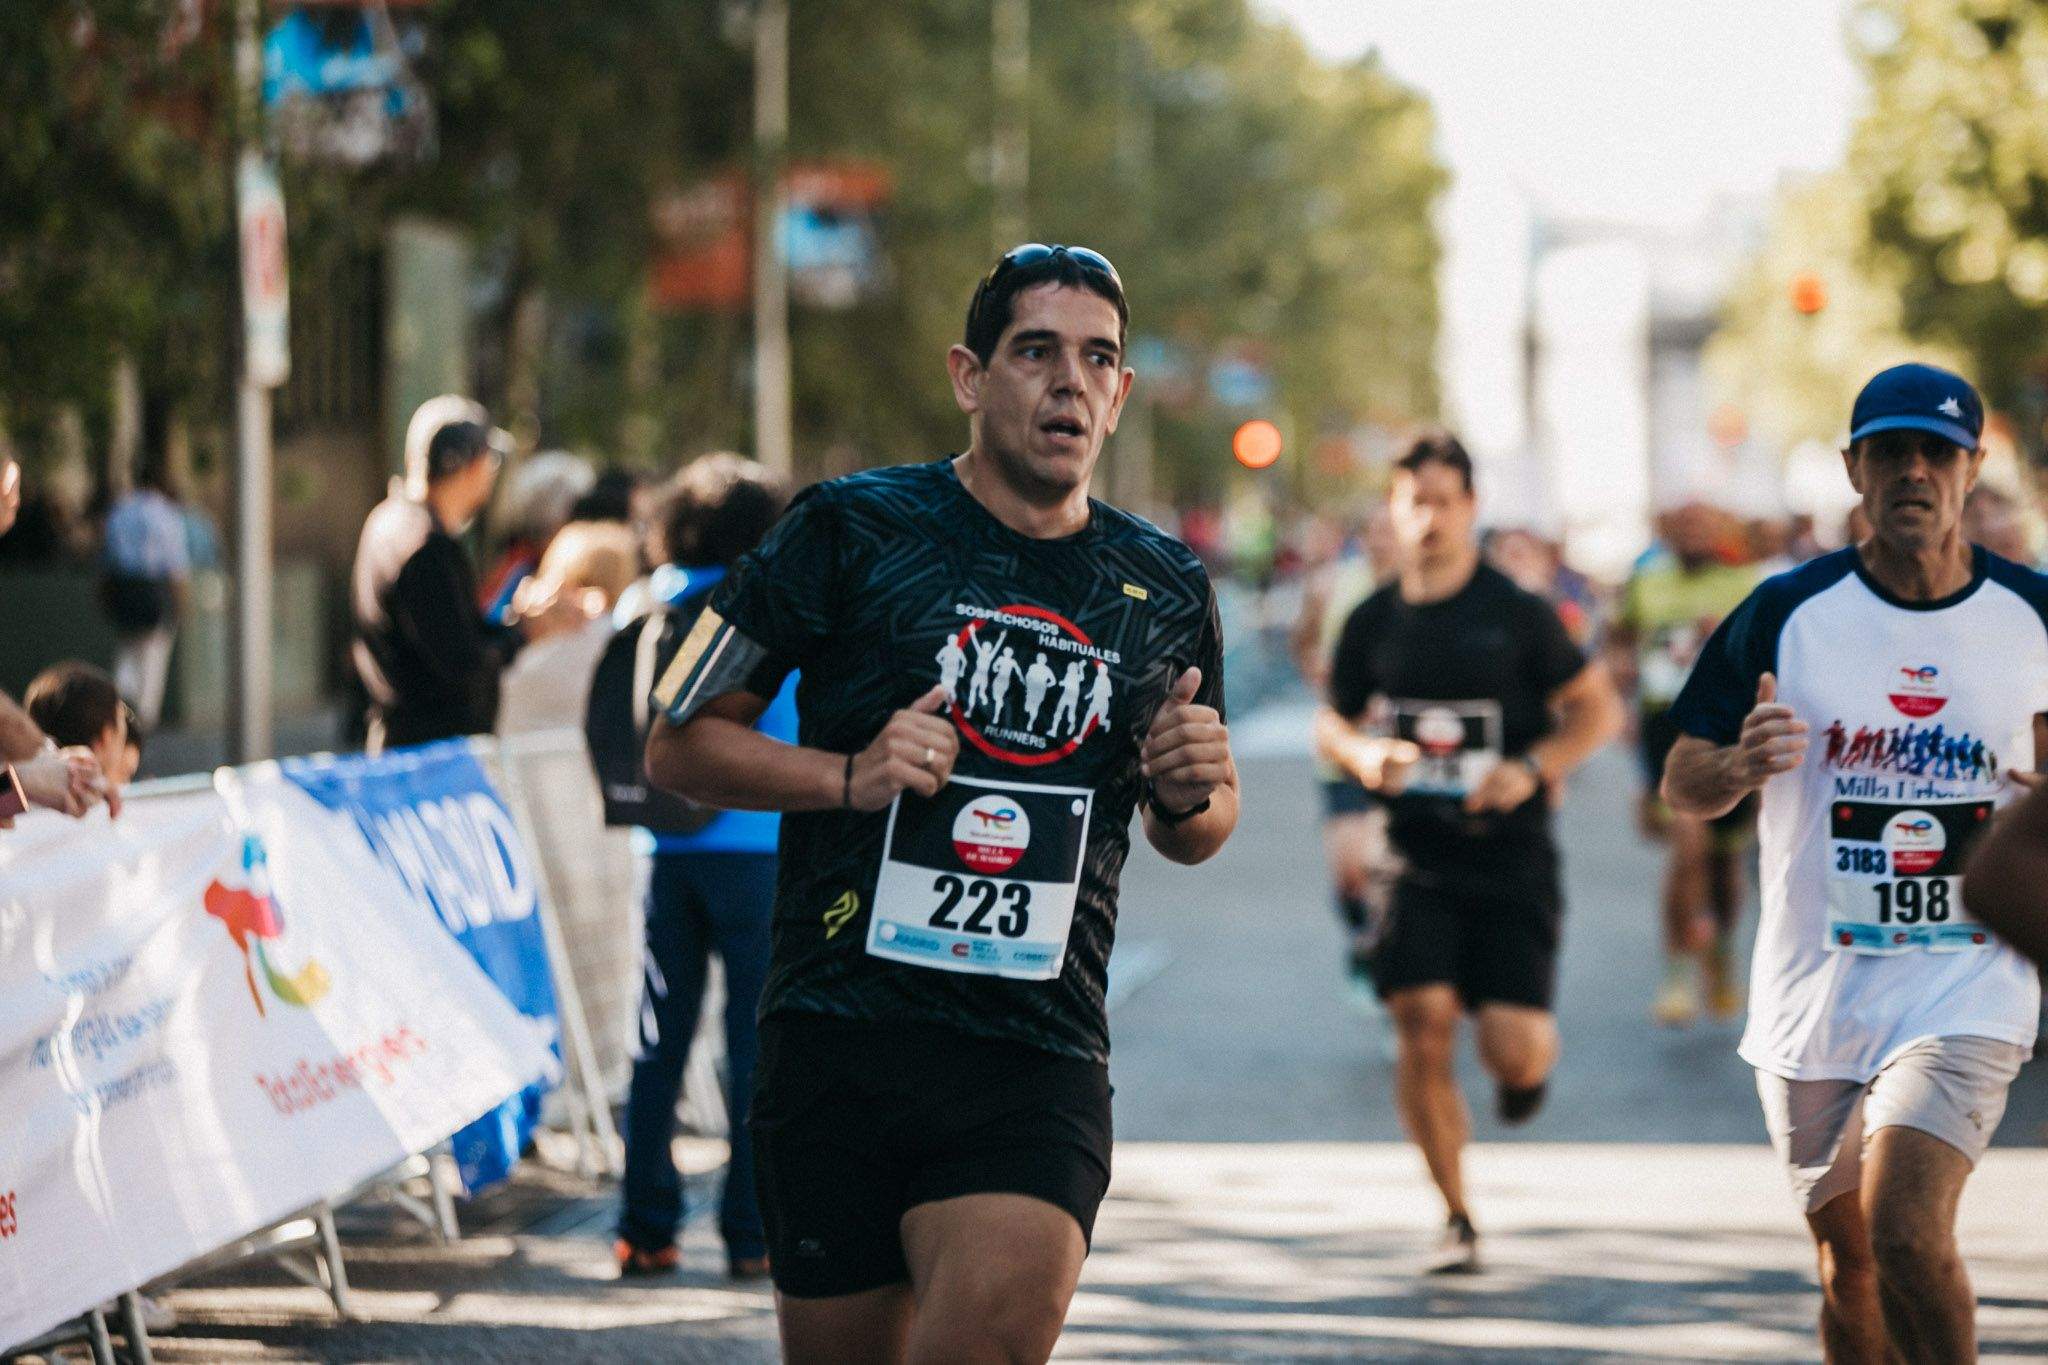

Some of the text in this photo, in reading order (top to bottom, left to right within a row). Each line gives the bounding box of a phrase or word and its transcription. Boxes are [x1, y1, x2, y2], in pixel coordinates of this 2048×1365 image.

[955, 603, 1060, 636] SOSPECHOSOS
[1038, 633, 1121, 664] HABITUALES
[984, 725, 1047, 749] RUNNERS
[1836, 846, 1887, 875] 3183
[929, 875, 1031, 938] 223
[1872, 878, 1950, 924] 198
